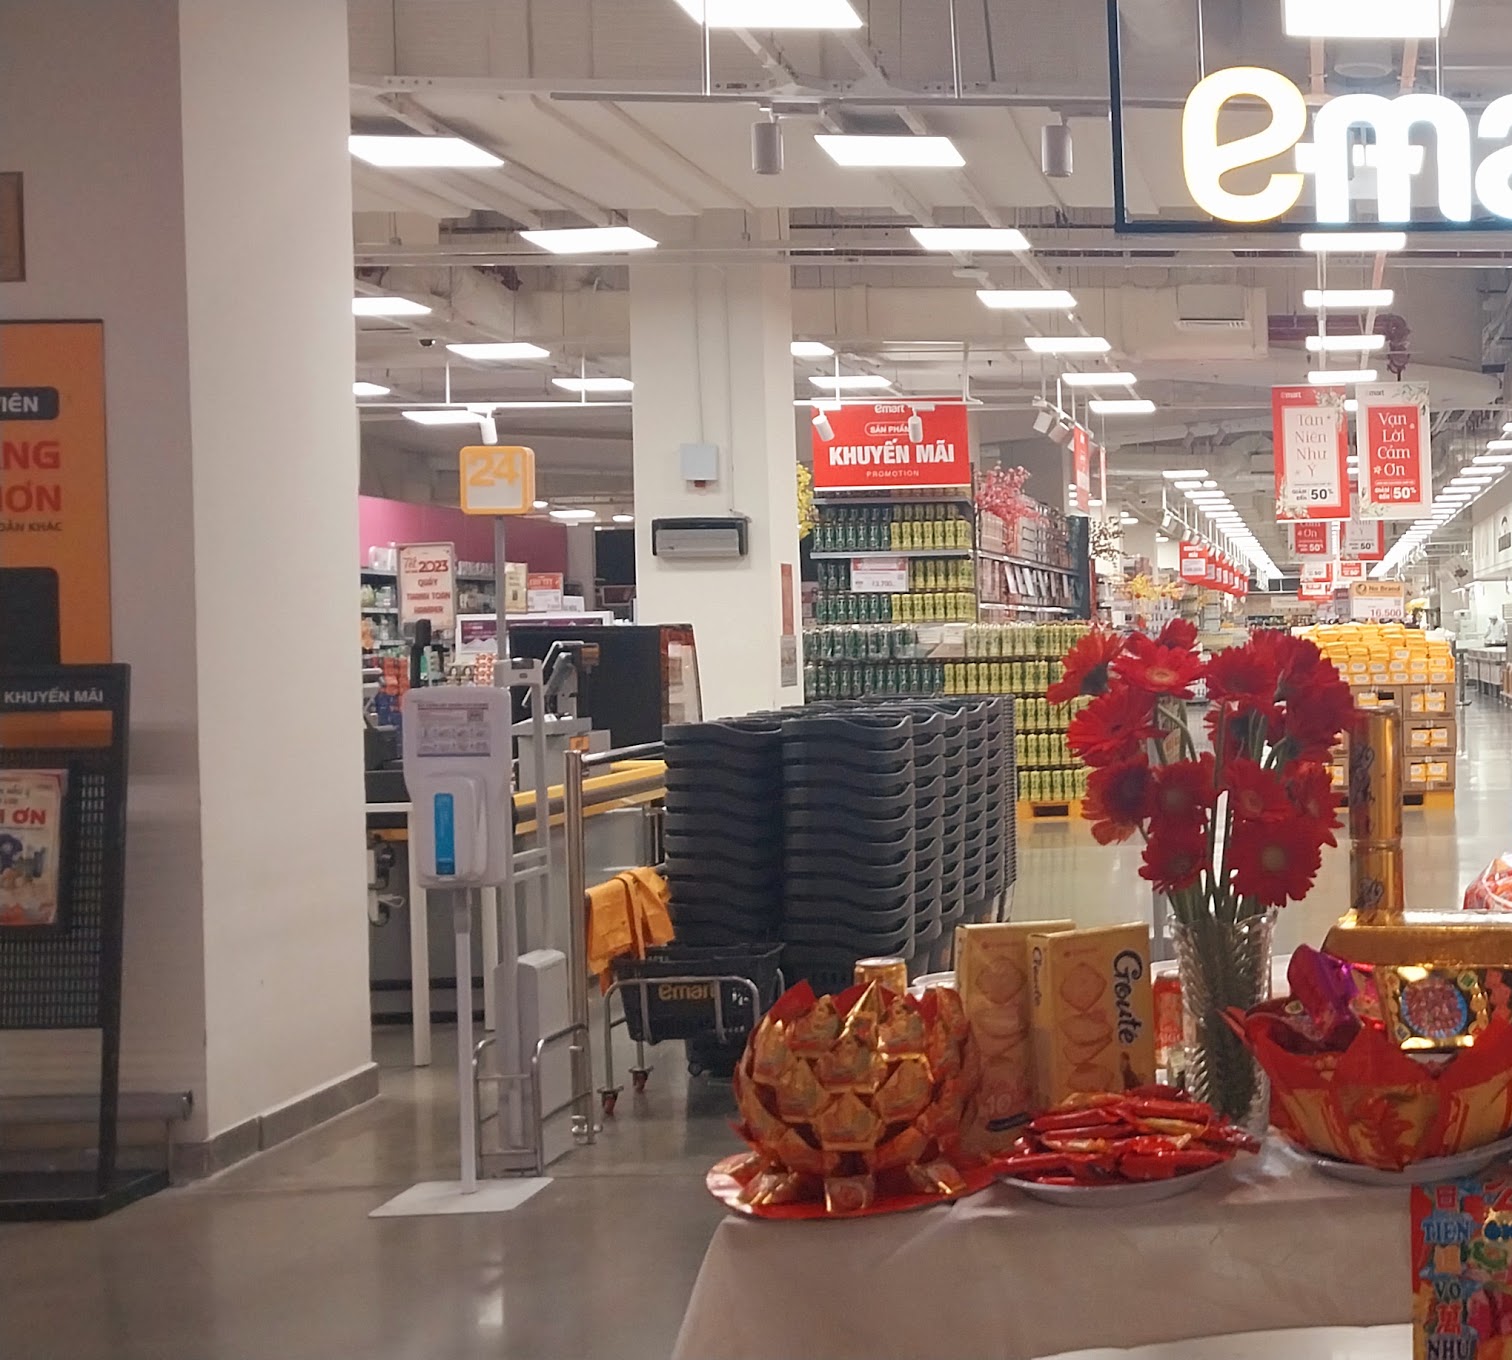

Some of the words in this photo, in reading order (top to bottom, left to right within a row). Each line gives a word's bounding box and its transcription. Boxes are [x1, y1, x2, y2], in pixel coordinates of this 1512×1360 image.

[0, 392, 39, 413] IÊN
[874, 403, 905, 414] emart
[1378, 412, 1407, 428] Vạn
[1382, 428, 1406, 443] Lời
[0, 440, 61, 470] NG
[829, 438, 910, 466] KHUYẾN
[915, 439, 955, 464] MÃI
[469, 453, 520, 487] 24
[866, 469, 920, 478] PROMOTION
[1384, 462, 1406, 476] Ơn
[0, 480, 62, 513] ƠN
[1310, 488, 1334, 500] 50%
[1393, 486, 1417, 500] 50%
[418, 559, 450, 573] 2023
[4, 687, 70, 704] KHUYẾN
[74, 686, 104, 702] MÃI
[12, 806, 46, 825] ƠN
[1113, 950, 1143, 1044] Gouté
